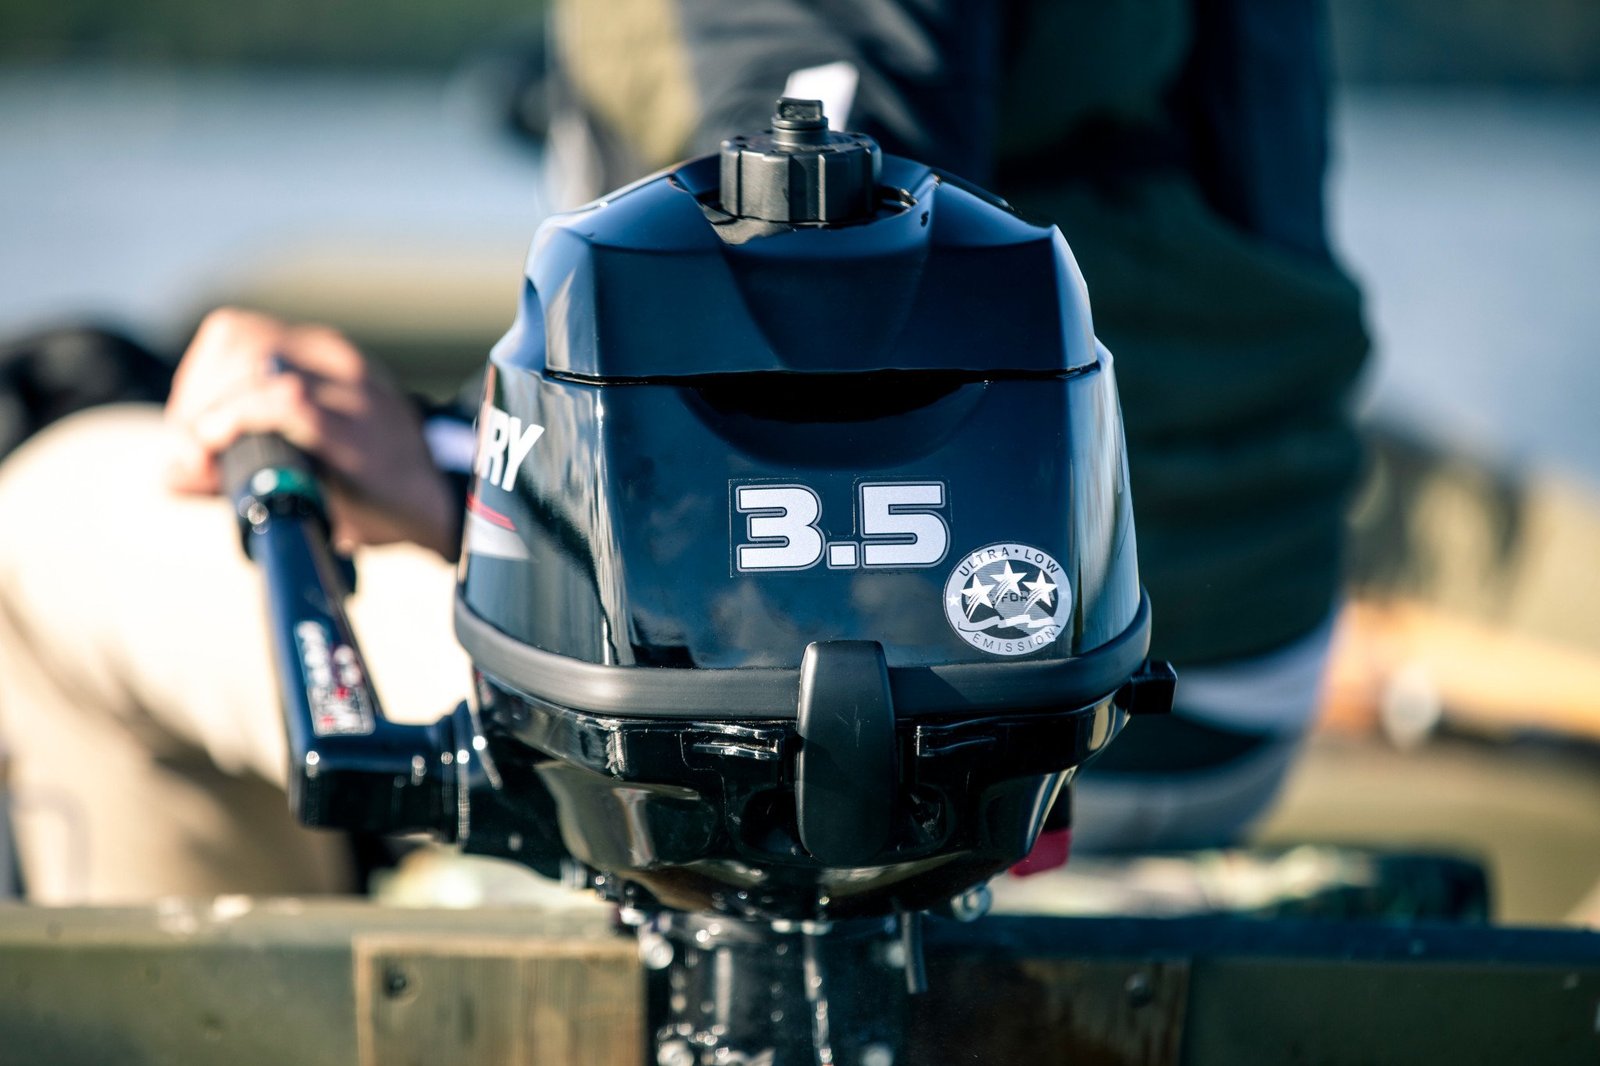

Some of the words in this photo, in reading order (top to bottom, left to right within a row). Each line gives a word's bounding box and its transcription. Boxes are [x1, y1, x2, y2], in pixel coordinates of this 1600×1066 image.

[477, 402, 545, 492] RY
[736, 481, 950, 572] 3.5
[959, 547, 1010, 577] ULTRA
[1024, 549, 1060, 574] LOW
[972, 627, 1056, 653] EMISSION
